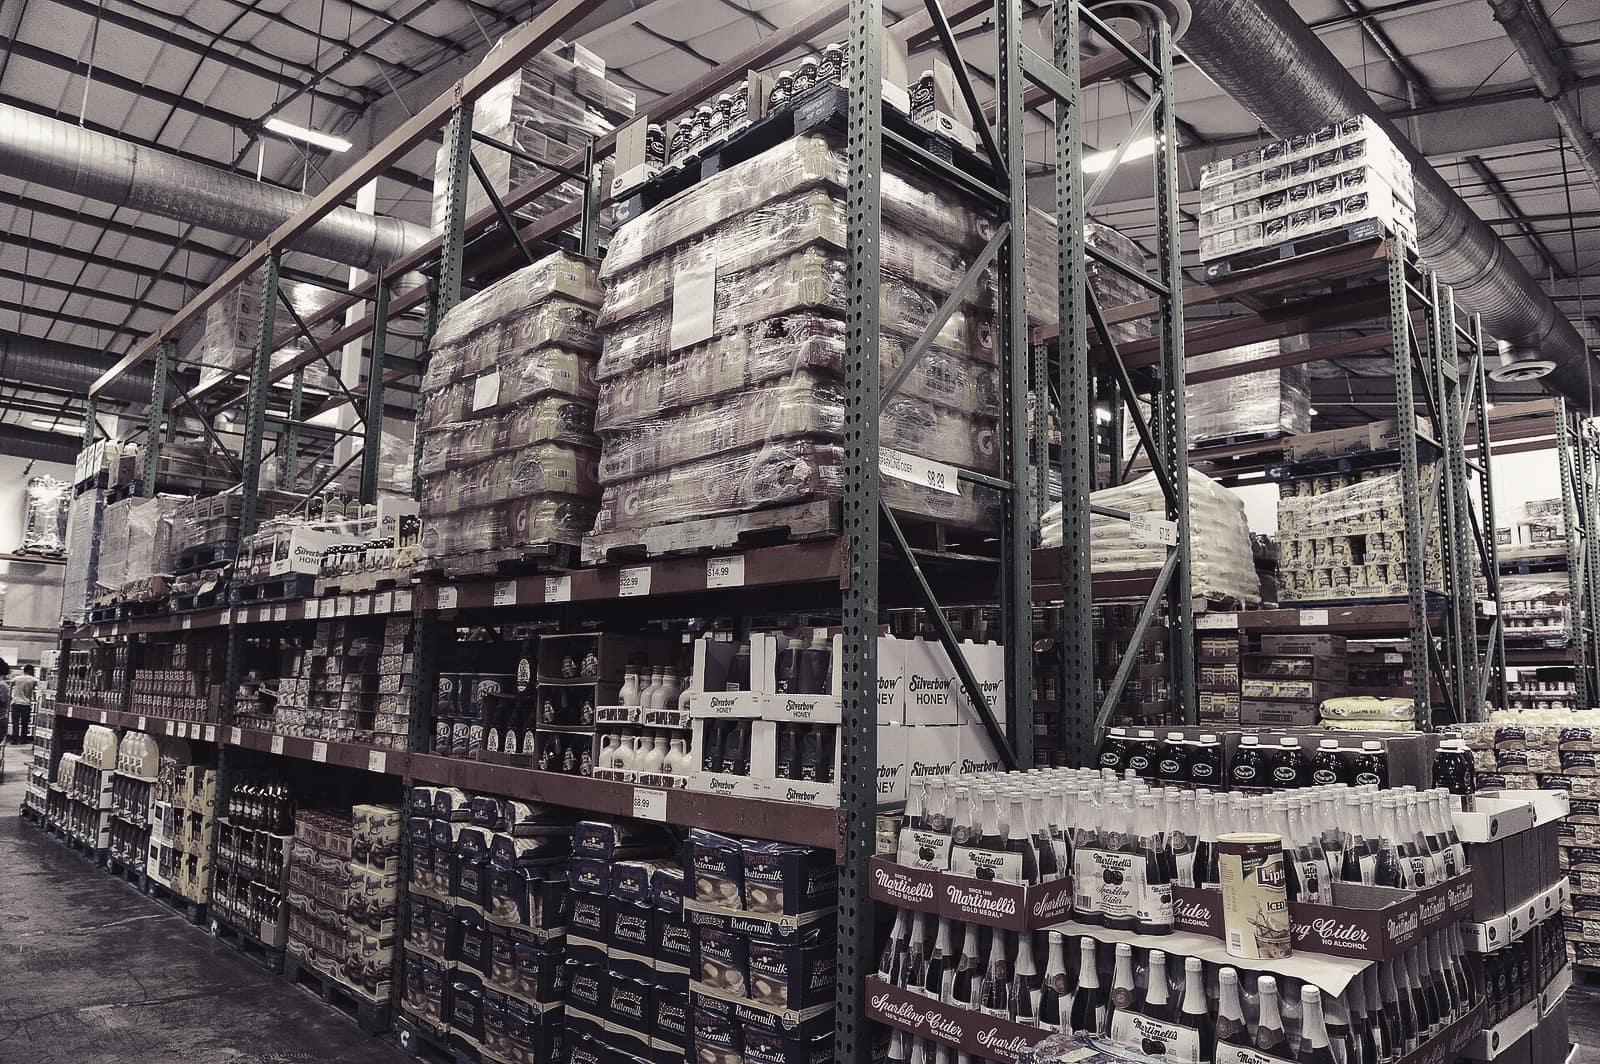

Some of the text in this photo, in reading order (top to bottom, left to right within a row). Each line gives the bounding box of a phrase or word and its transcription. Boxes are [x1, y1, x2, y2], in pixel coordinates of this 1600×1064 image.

[707, 567, 729, 577] $14.99
[620, 577, 638, 587] $22.99
[909, 675, 955, 692] Silverbow
[786, 700, 818, 711] Silverbow
[916, 693, 949, 704] HONEY
[911, 761, 956, 777] Silverbow
[786, 788, 819, 801] Silverbow
[694, 862, 727, 872] uttermilk
[744, 868, 783, 881] Buttermilk
[1261, 869, 1285, 885] Lipt
[946, 885, 1016, 915] Martinelli's
[961, 905, 978, 914] GOLD
[1173, 898, 1212, 920] Cider
[730, 917, 773, 935] Buttermilk
[1182, 918, 1210, 928] ALCOHOL
[1312, 918, 1370, 943] Cider
[615, 924, 647, 942] Buttermilk
[662, 936, 691, 953] Buttermi
[1321, 938, 1368, 950] NO ALCOHOL
[611, 999, 642, 1018] Buttermilk
[735, 1004, 776, 1028] Buttermilk
[872, 993, 964, 1039] Sparkling Cider
[657, 1014, 686, 1033] Buttermi
[1133, 1018, 1178, 1041] Martinelli's
[977, 1028, 1027, 1053] Sparkl
[745, 1045, 787, 1064] Buttermilk
